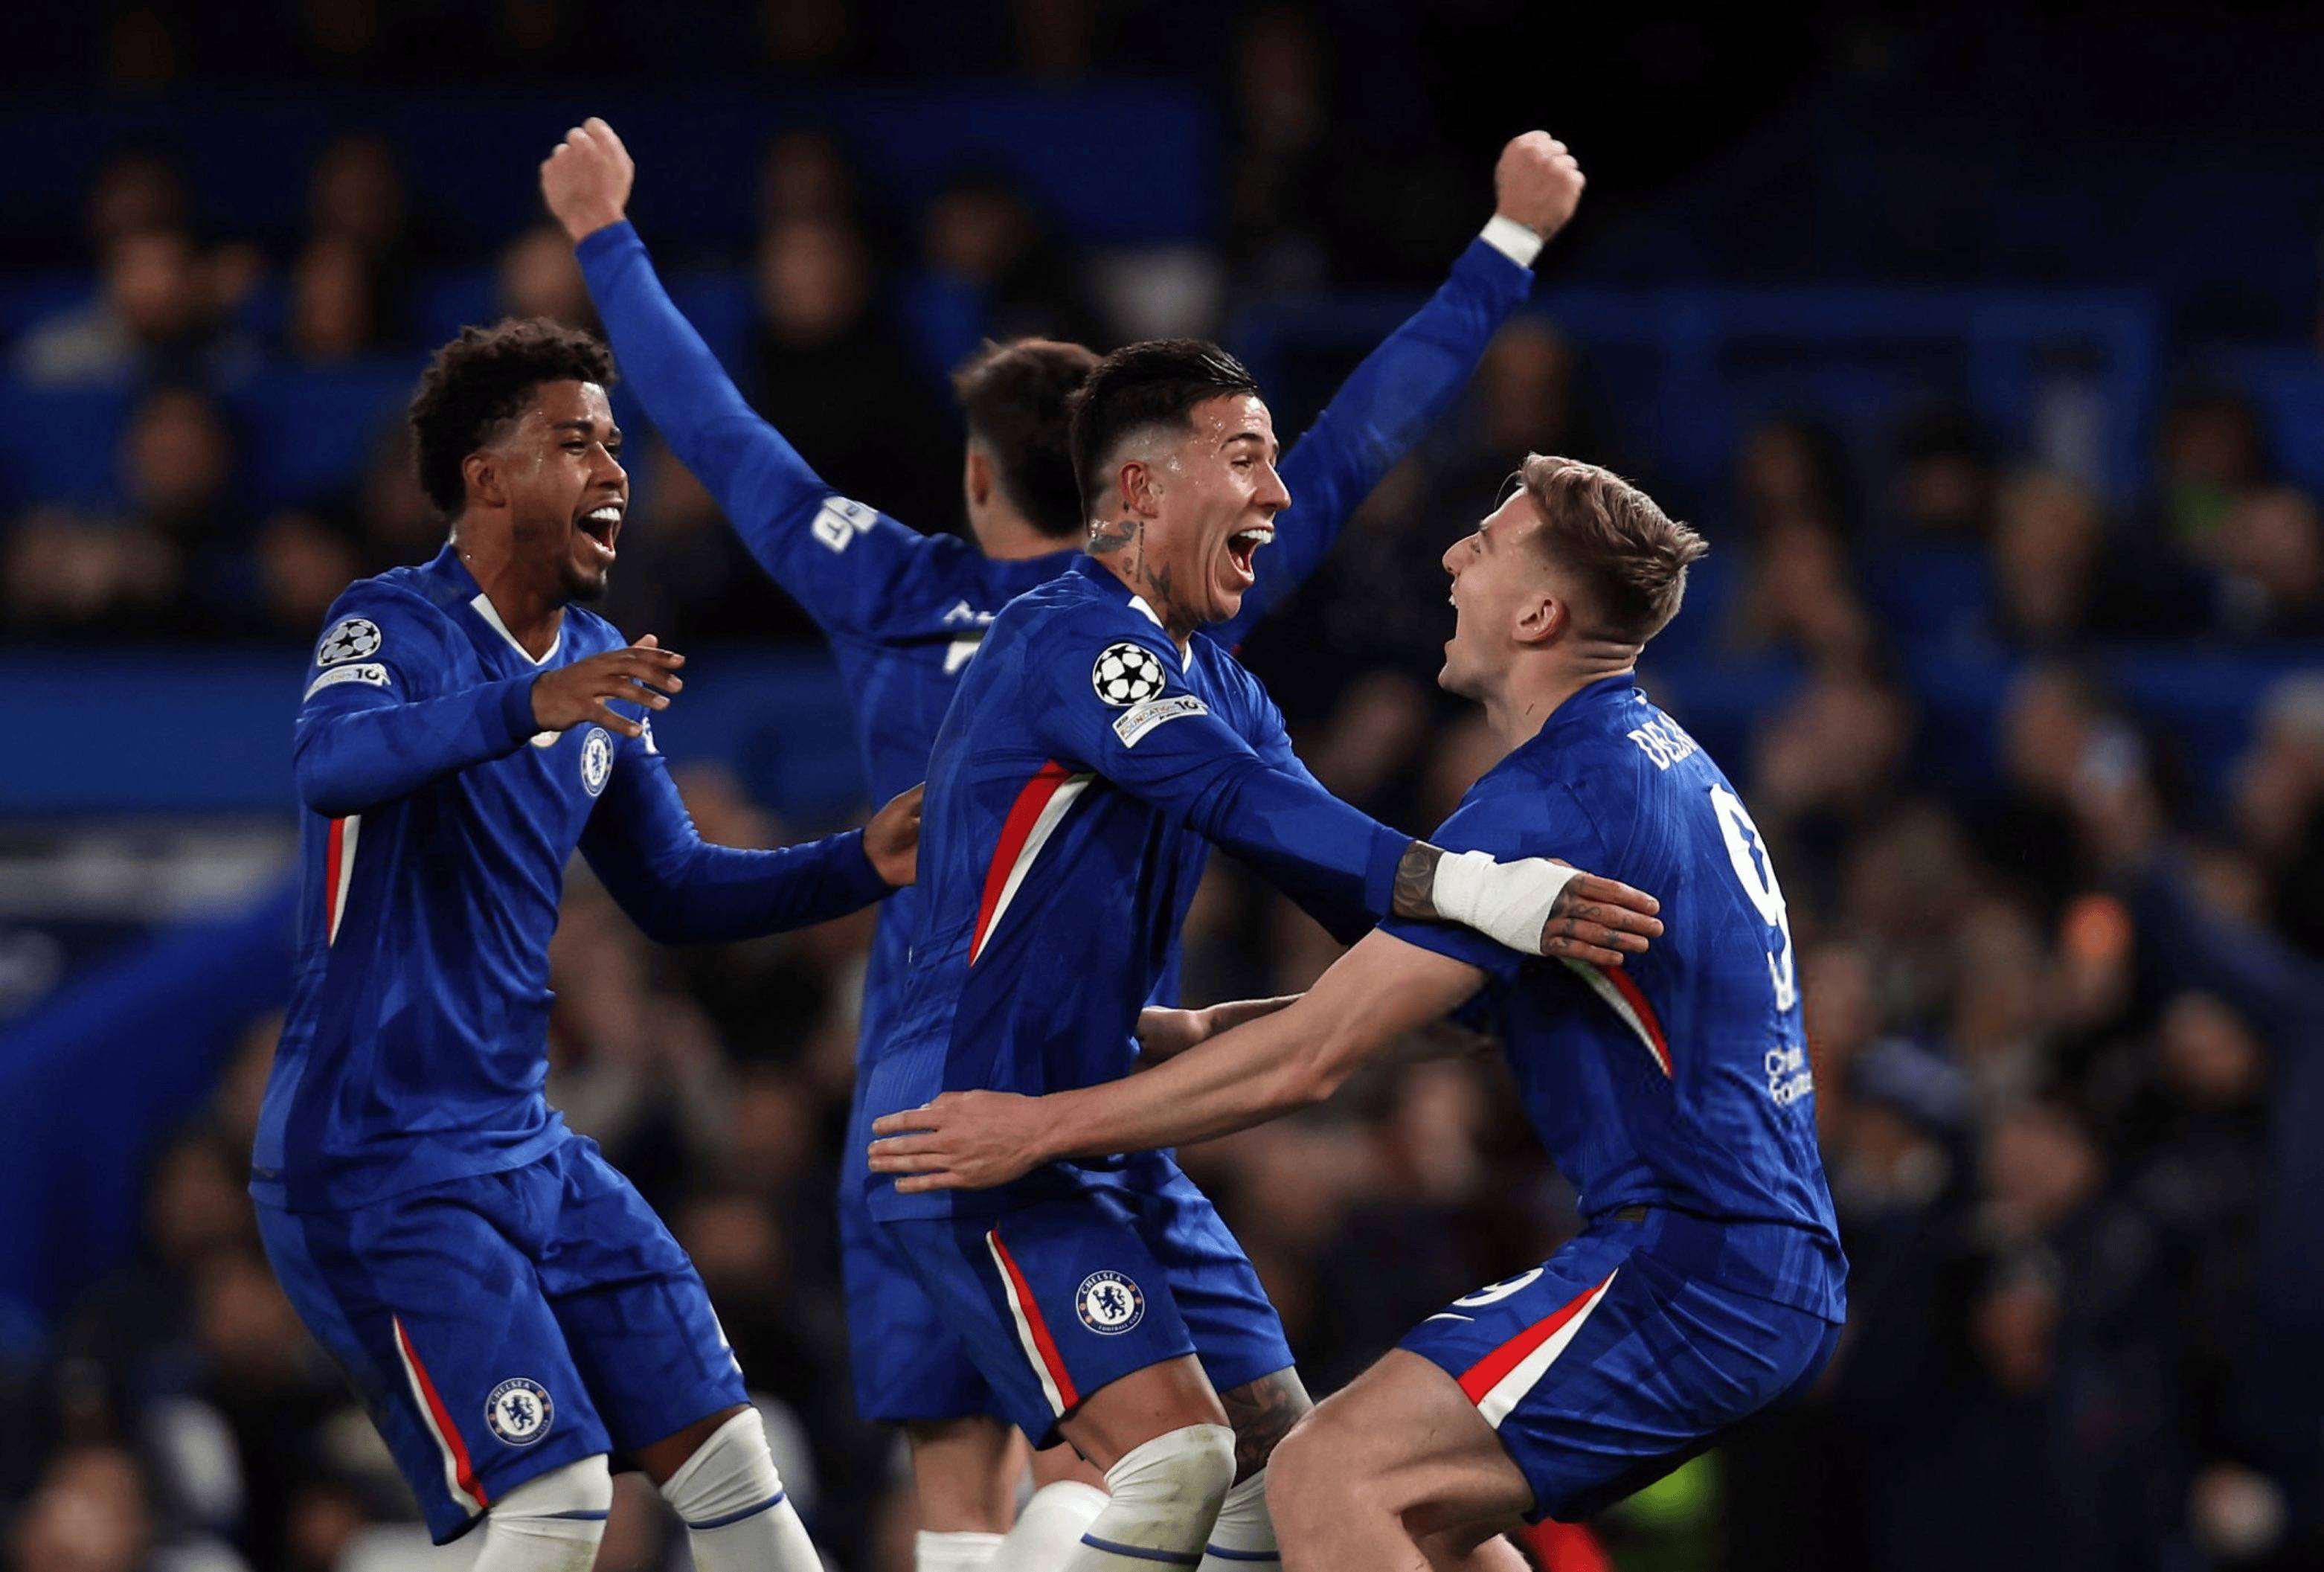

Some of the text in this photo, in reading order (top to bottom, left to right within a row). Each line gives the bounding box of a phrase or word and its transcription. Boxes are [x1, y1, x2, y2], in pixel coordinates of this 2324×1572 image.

[356, 669, 379, 681] 10
[1175, 700, 1199, 710] 10
[1710, 783, 1794, 1011] 9
[1081, 1273, 1121, 1295] CHELSEA
